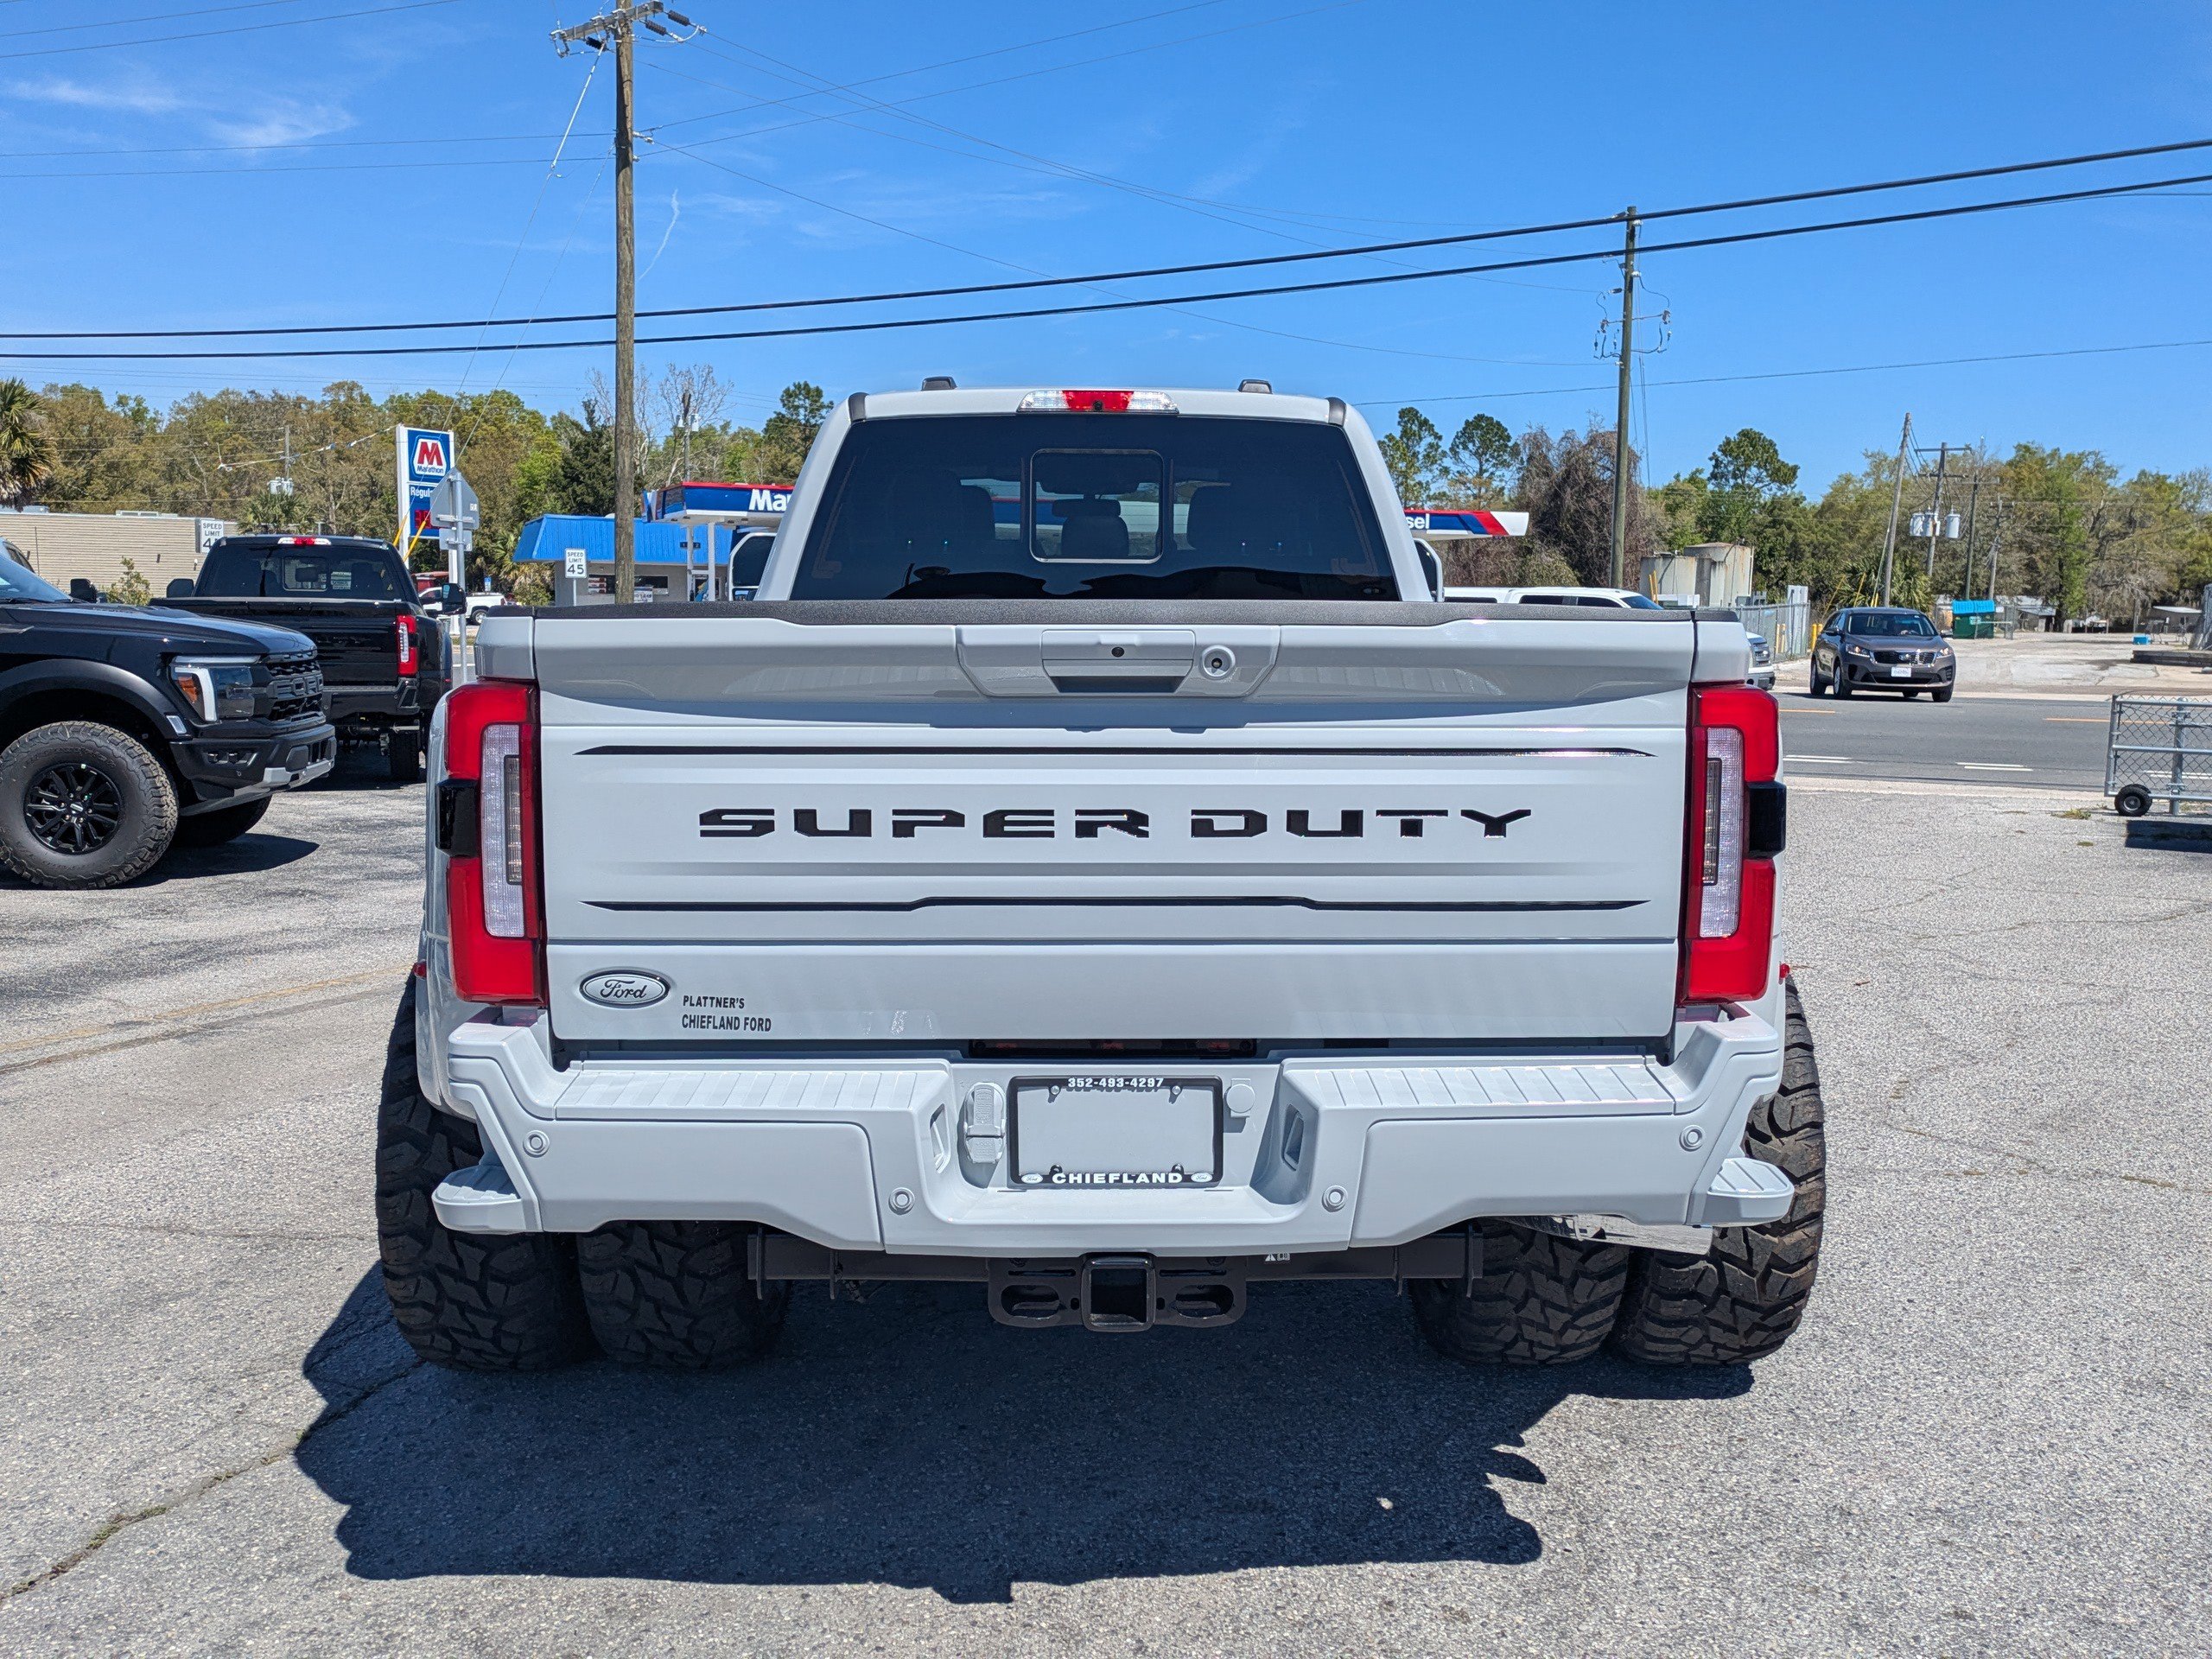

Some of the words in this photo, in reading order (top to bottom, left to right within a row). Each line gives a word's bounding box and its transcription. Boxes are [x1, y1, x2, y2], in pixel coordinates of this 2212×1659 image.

[417, 442, 443, 467] M
[416, 465, 444, 474] Marathon
[410, 486, 432, 499] Regul
[202, 537, 218, 550] 4
[567, 563, 584, 575] 45
[699, 808, 1149, 838] SUPER
[1191, 808, 1531, 838] DUTY
[600, 978, 648, 999] Ford
[683, 995, 746, 1009] PLATTNER'S
[681, 1014, 741, 1031] CHIEFLAND
[743, 1016, 772, 1033] FORD
[1067, 1077, 1165, 1089] 352-493-4297
[1052, 1173, 1183, 1184] CHIEFLAND
